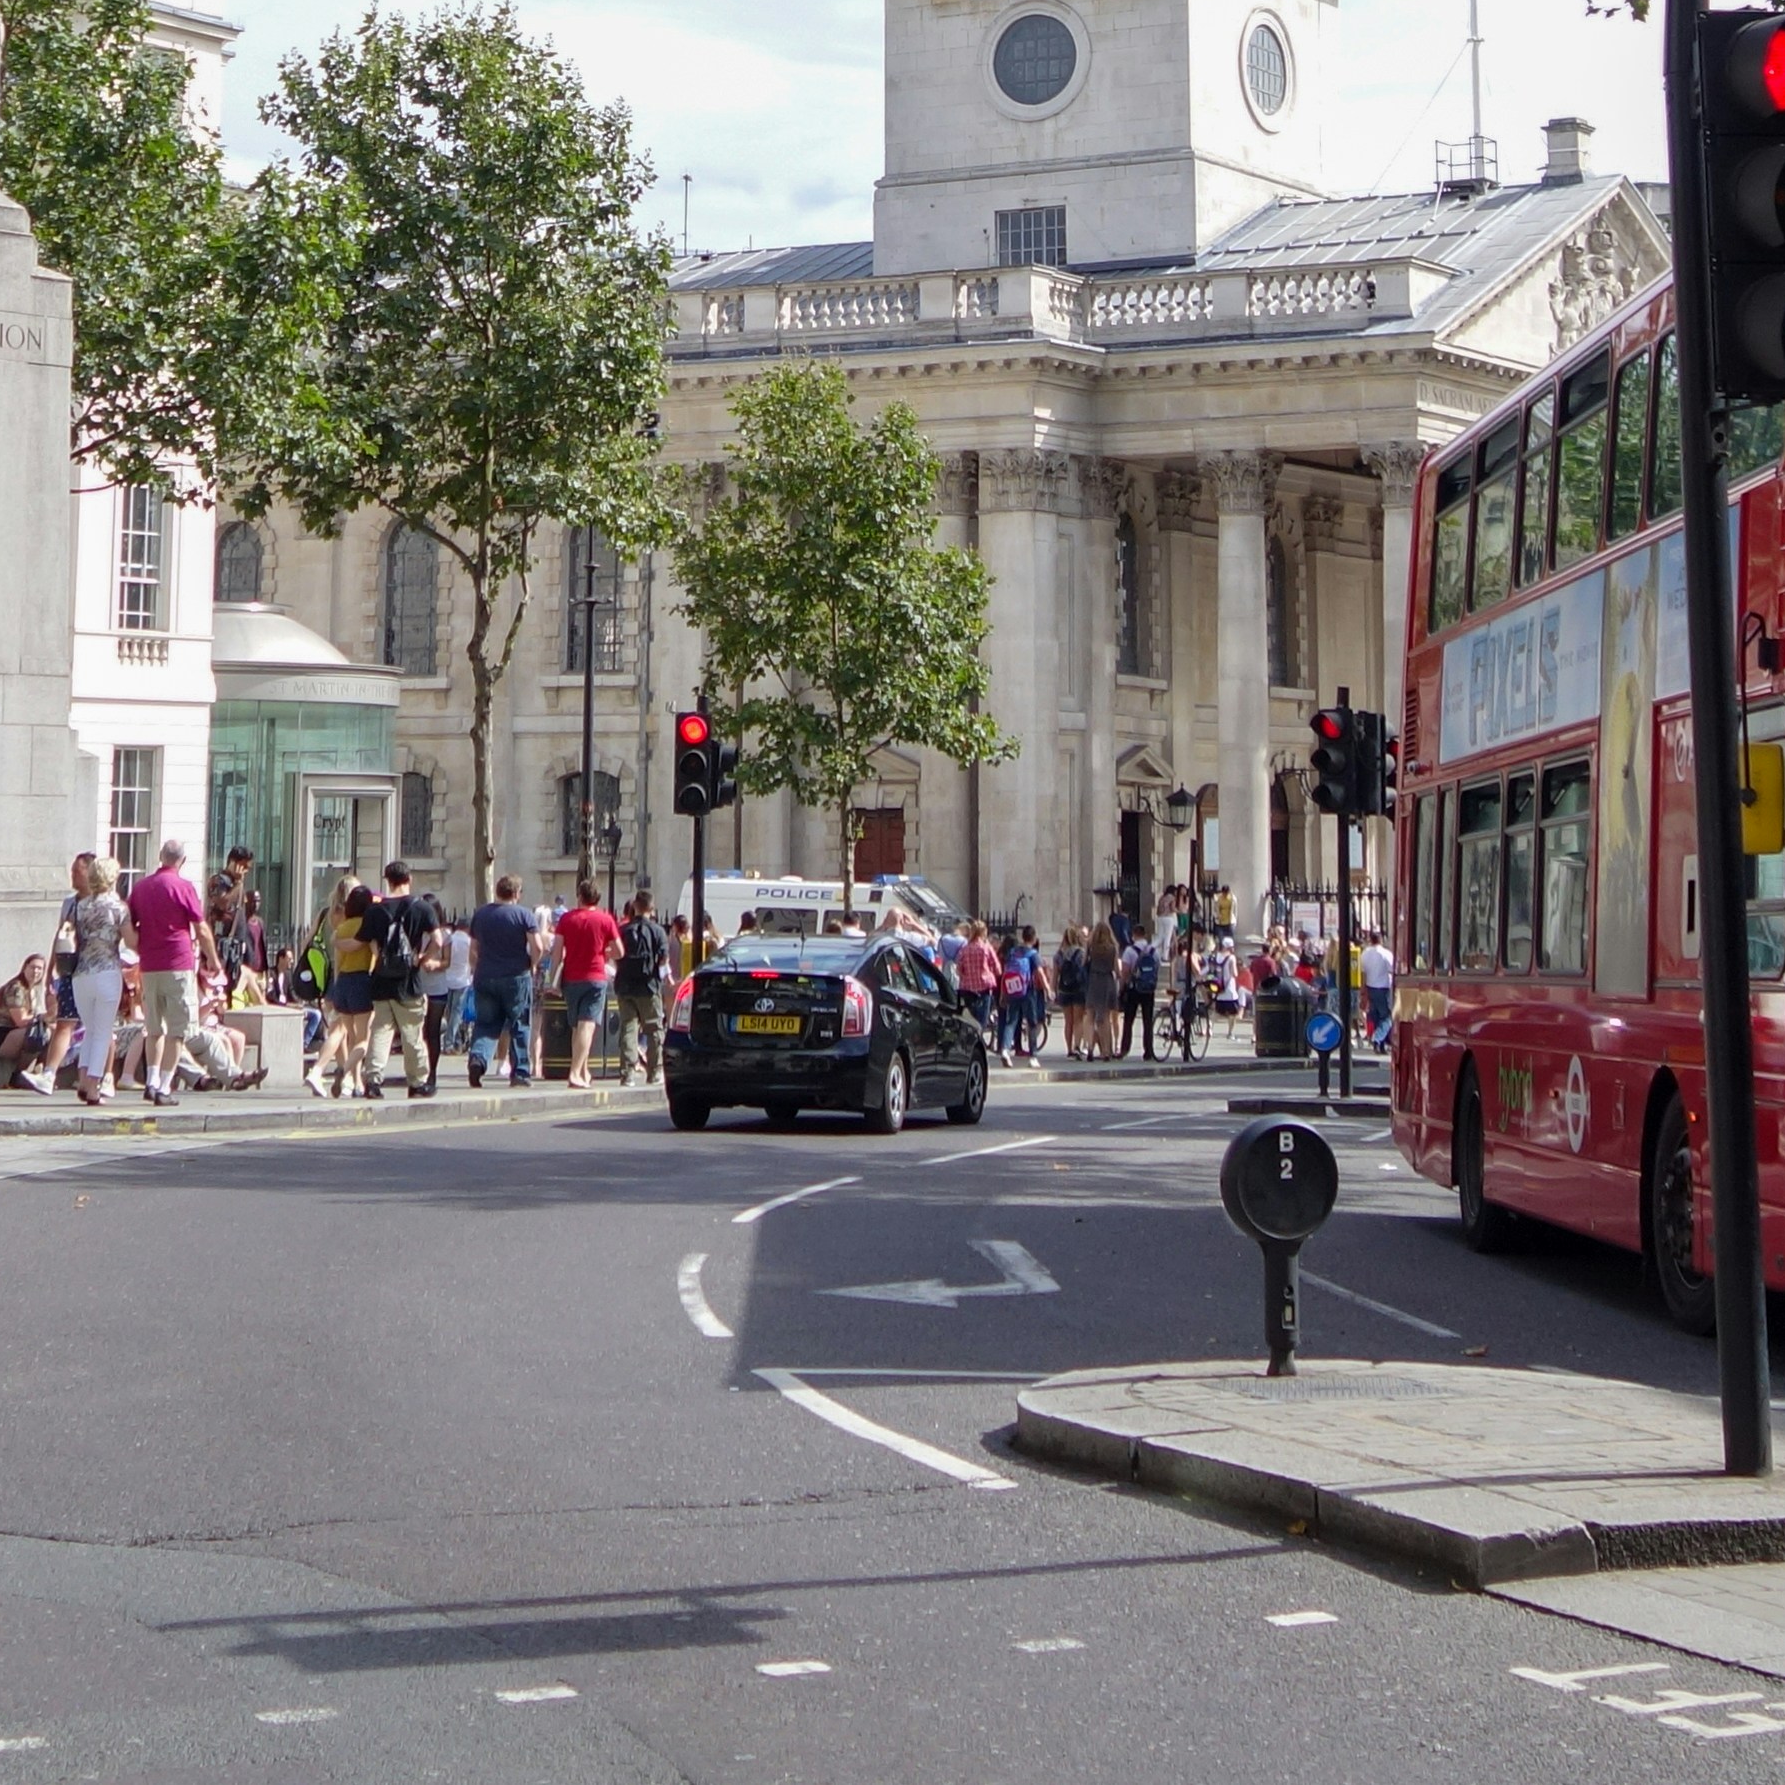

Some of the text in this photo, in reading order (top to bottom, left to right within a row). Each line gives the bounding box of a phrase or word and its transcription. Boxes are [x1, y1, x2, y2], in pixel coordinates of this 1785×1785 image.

[1469, 604, 1562, 747] PIXELS
[313, 813, 346, 832] Crypt
[755, 888, 833, 901] POLICE
[741, 1016, 766, 1030] LS14
[1498, 1048, 1533, 1133] hybrid
[1279, 1131, 1294, 1152] B
[1280, 1158, 1293, 1180] 2
